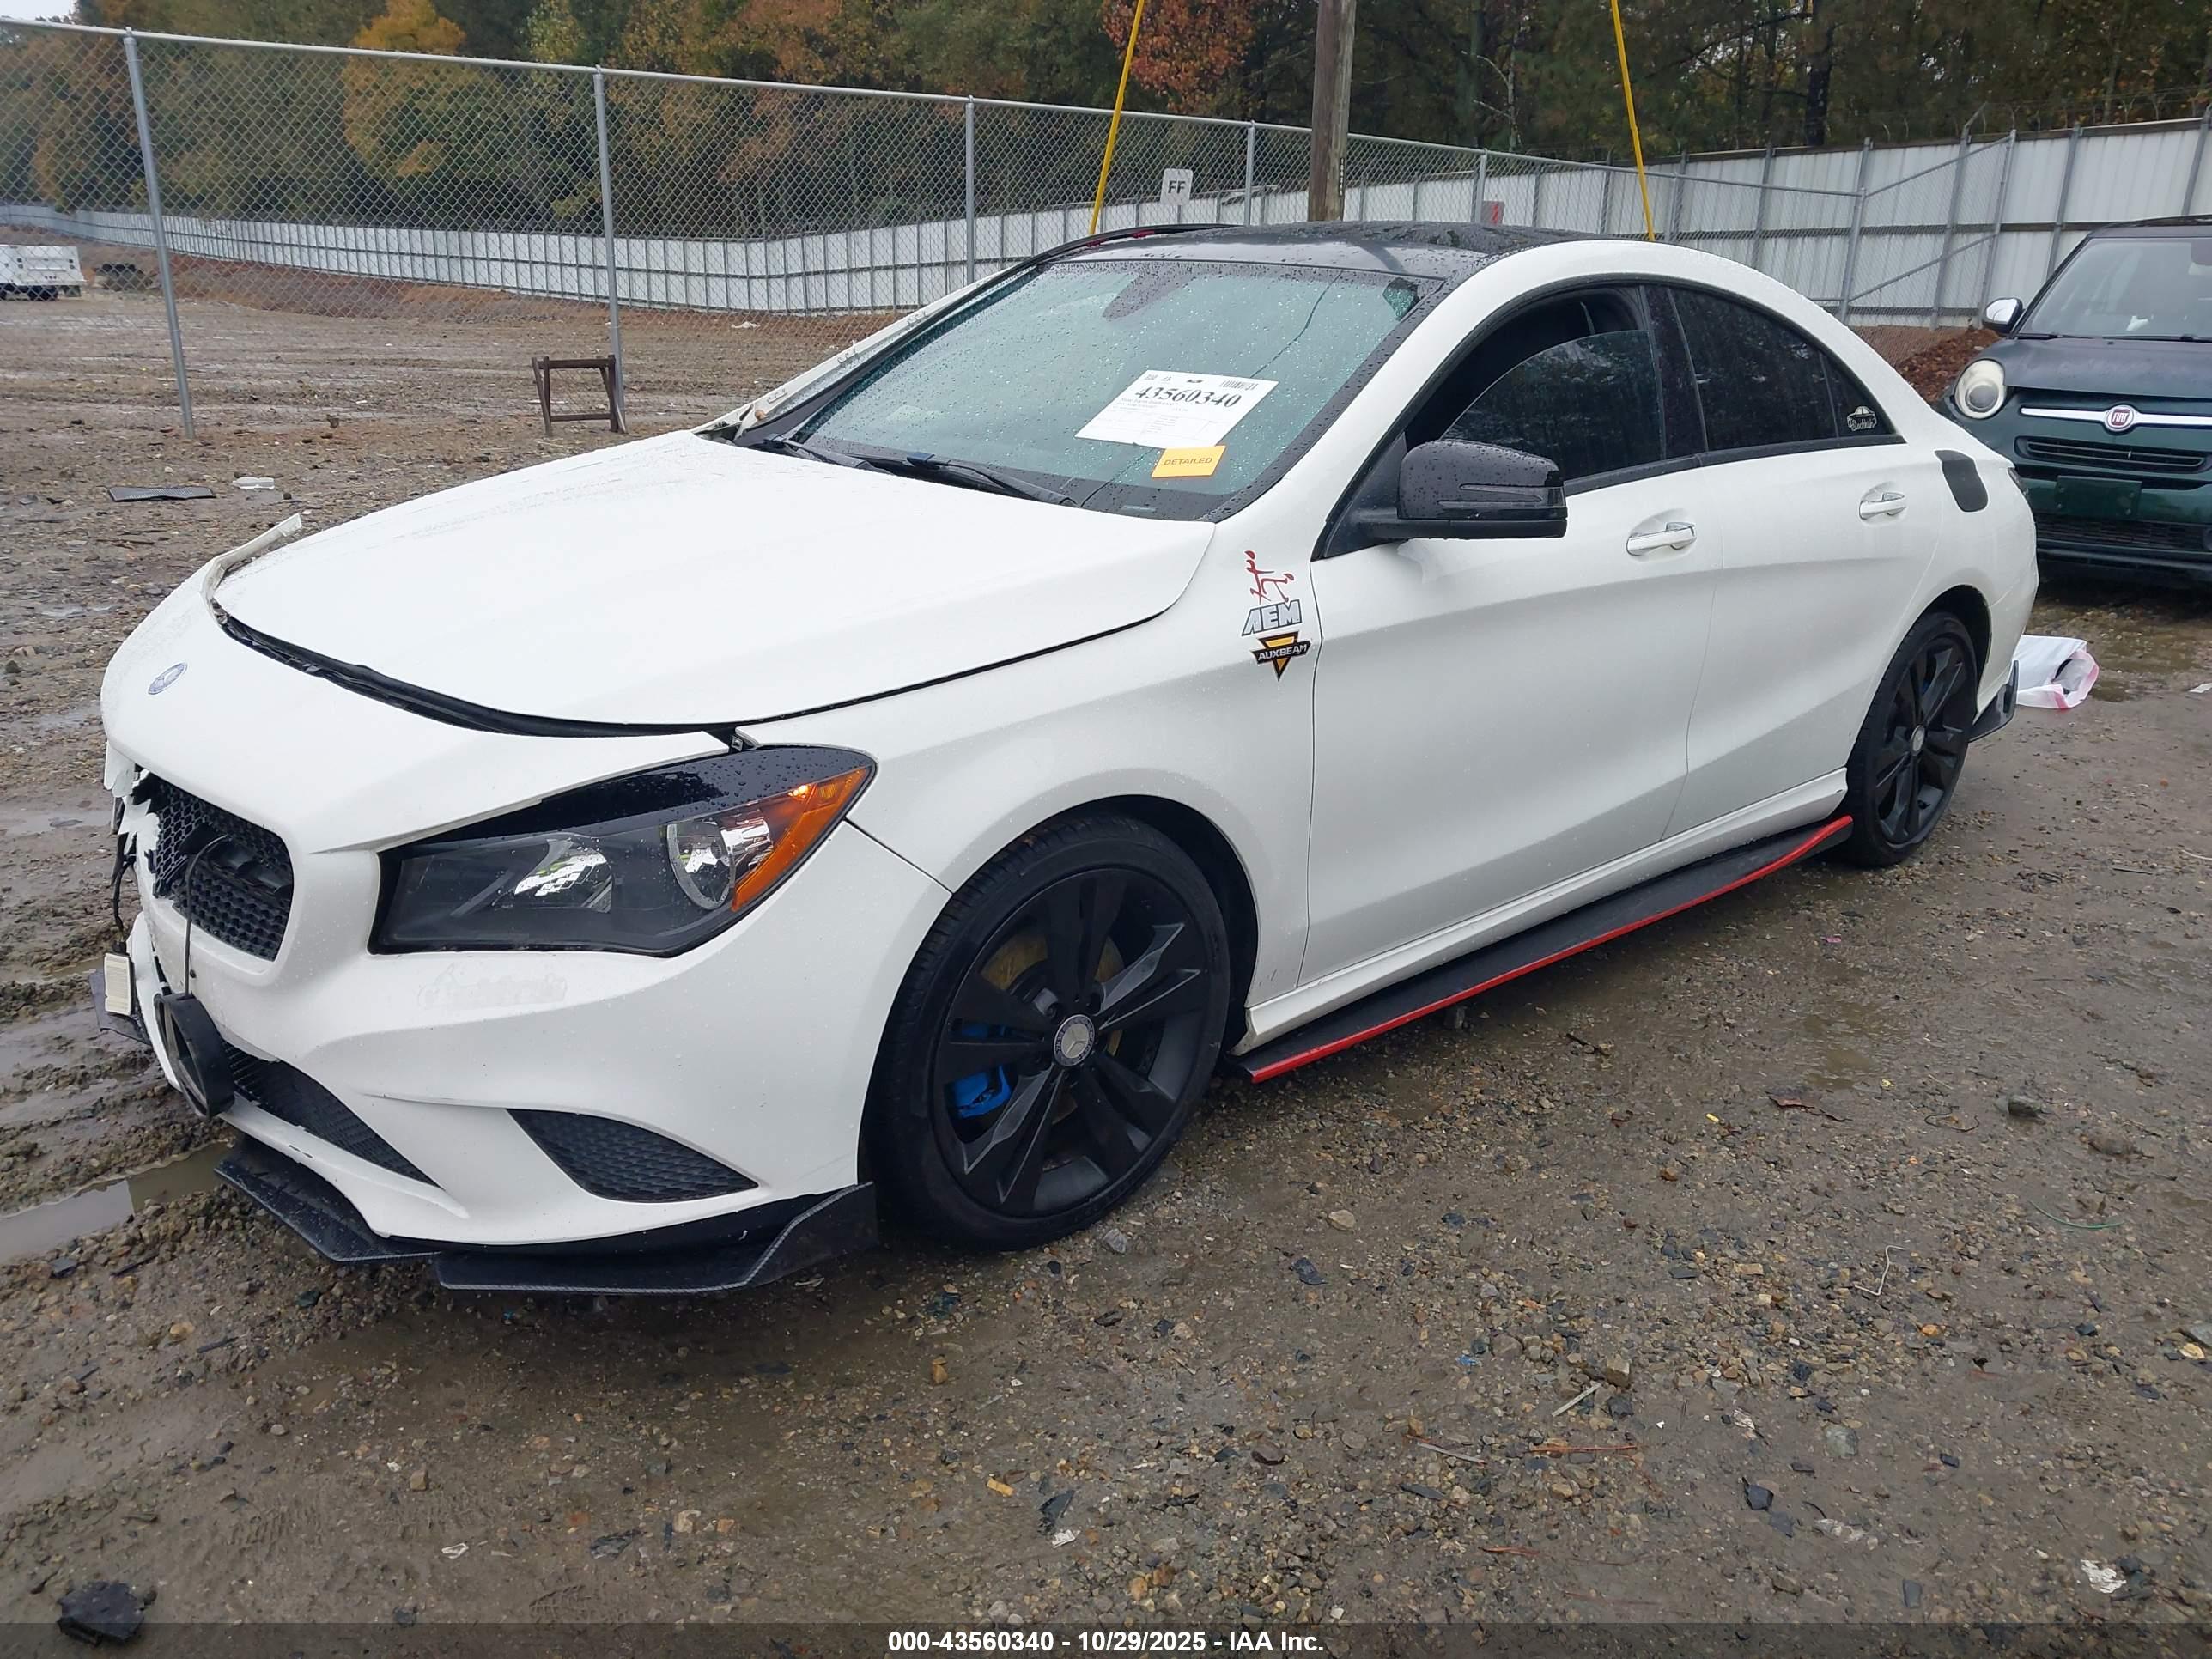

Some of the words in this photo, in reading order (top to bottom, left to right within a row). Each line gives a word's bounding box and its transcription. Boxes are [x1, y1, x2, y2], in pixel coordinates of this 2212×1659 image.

[1168, 180, 1186, 193] FF
[1134, 386, 1242, 408] 43560340
[1164, 457, 1213, 465] DETAILED
[1242, 599, 1303, 637] AEM
[1258, 644, 1307, 660] AUXBEAM
